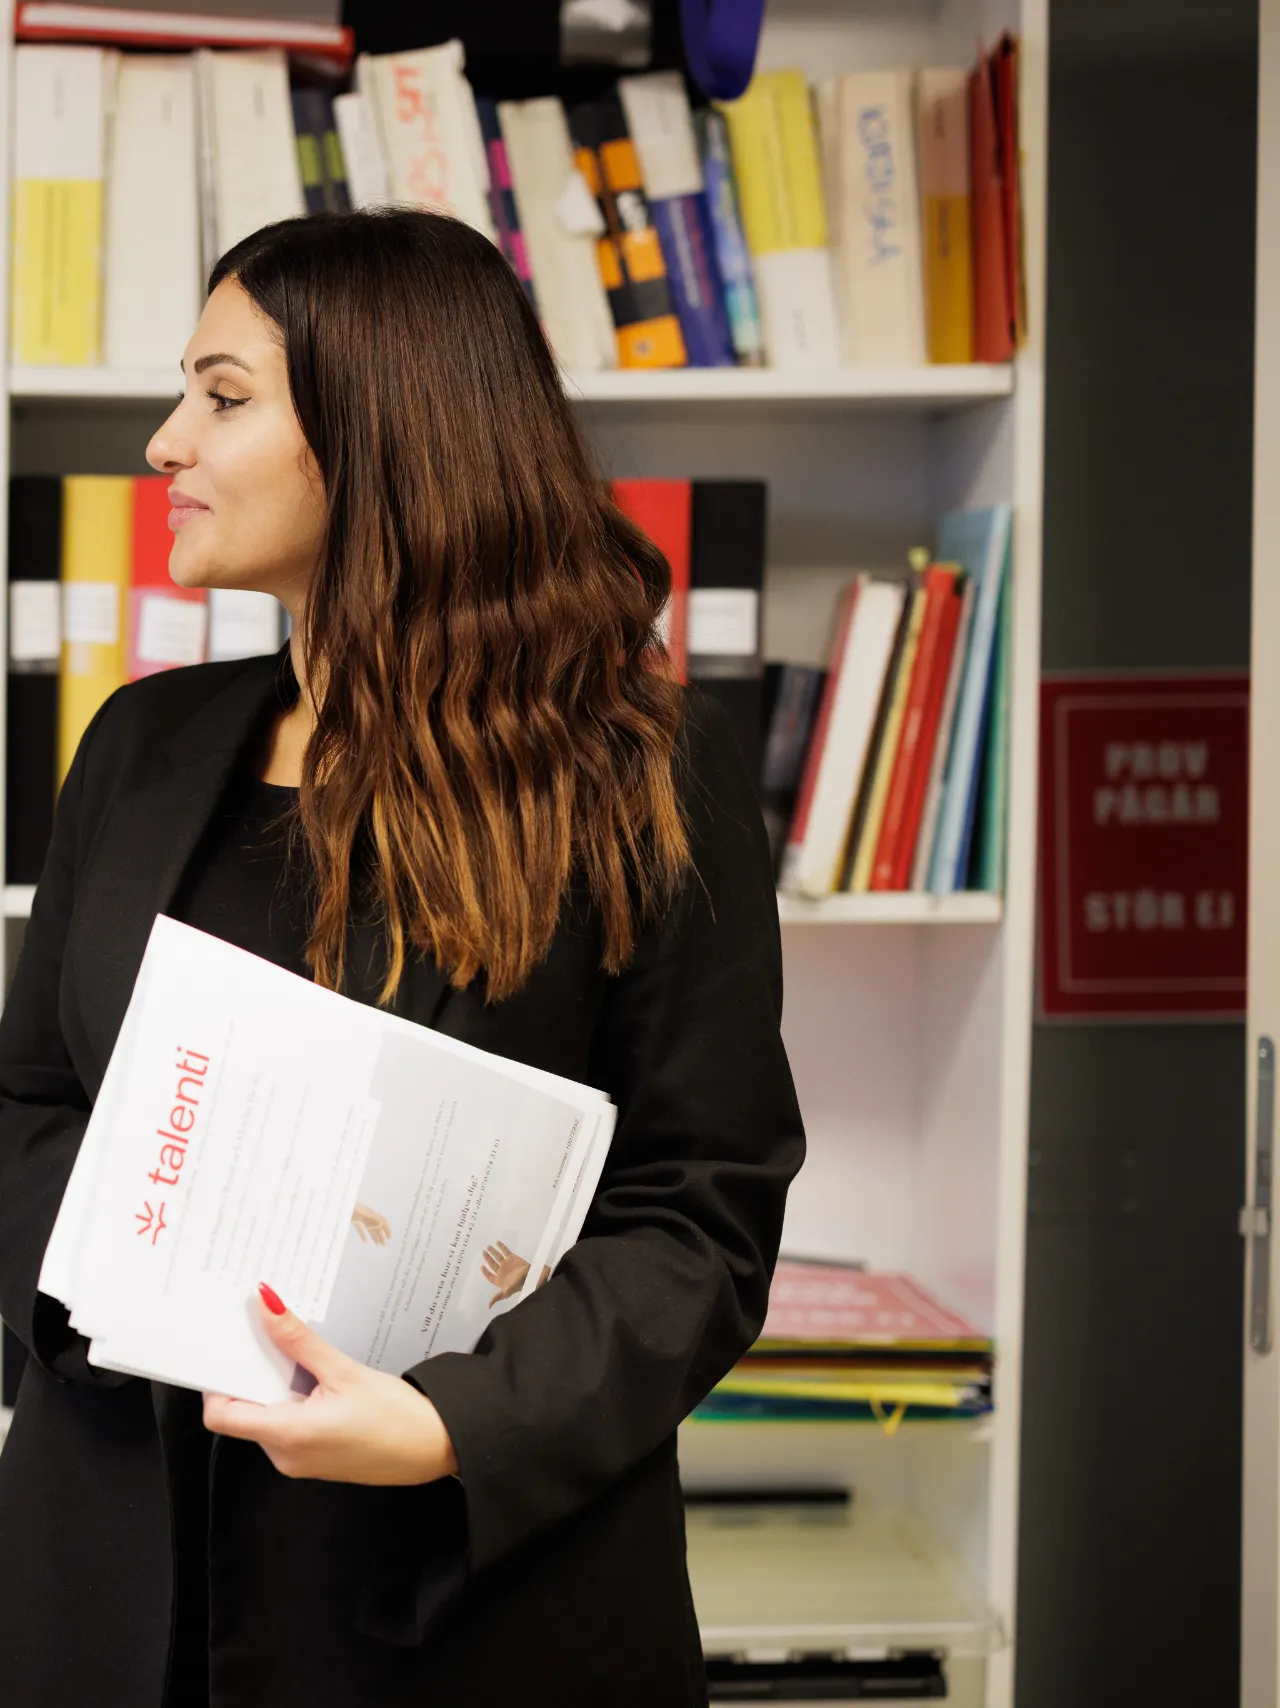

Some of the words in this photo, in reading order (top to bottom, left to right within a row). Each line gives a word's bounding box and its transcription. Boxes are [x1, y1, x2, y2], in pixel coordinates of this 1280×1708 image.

[148, 1046, 210, 1186] talenti
[421, 1316, 431, 1333] Vill
[428, 1300, 436, 1314] du
[434, 1279, 444, 1299] veta
[441, 1260, 450, 1277] hur
[447, 1248, 455, 1257] vi
[451, 1229, 460, 1247] kan
[457, 1197, 471, 1228] hjälpa
[467, 1174, 477, 1196] dig?
